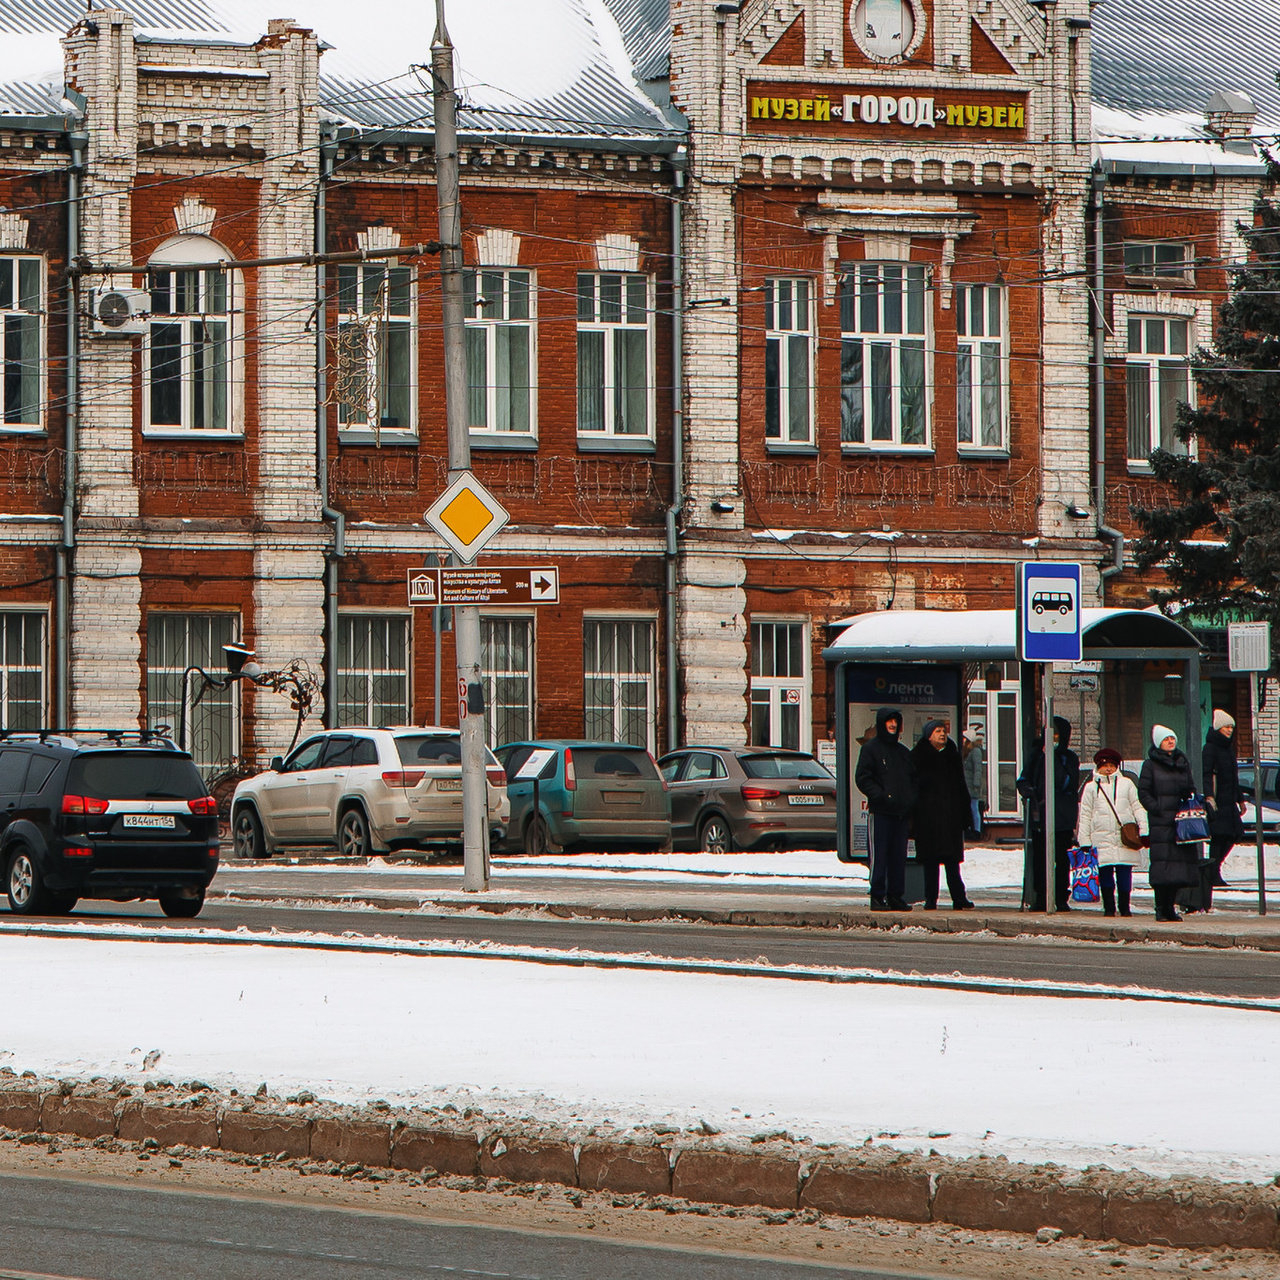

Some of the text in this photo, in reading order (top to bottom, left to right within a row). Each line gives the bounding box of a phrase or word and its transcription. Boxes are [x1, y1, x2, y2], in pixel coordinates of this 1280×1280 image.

[751, 94, 1024, 128] МУЗЕЙ «ГОРОД» МУЗЕЙ
[888, 683, 934, 695] лента
